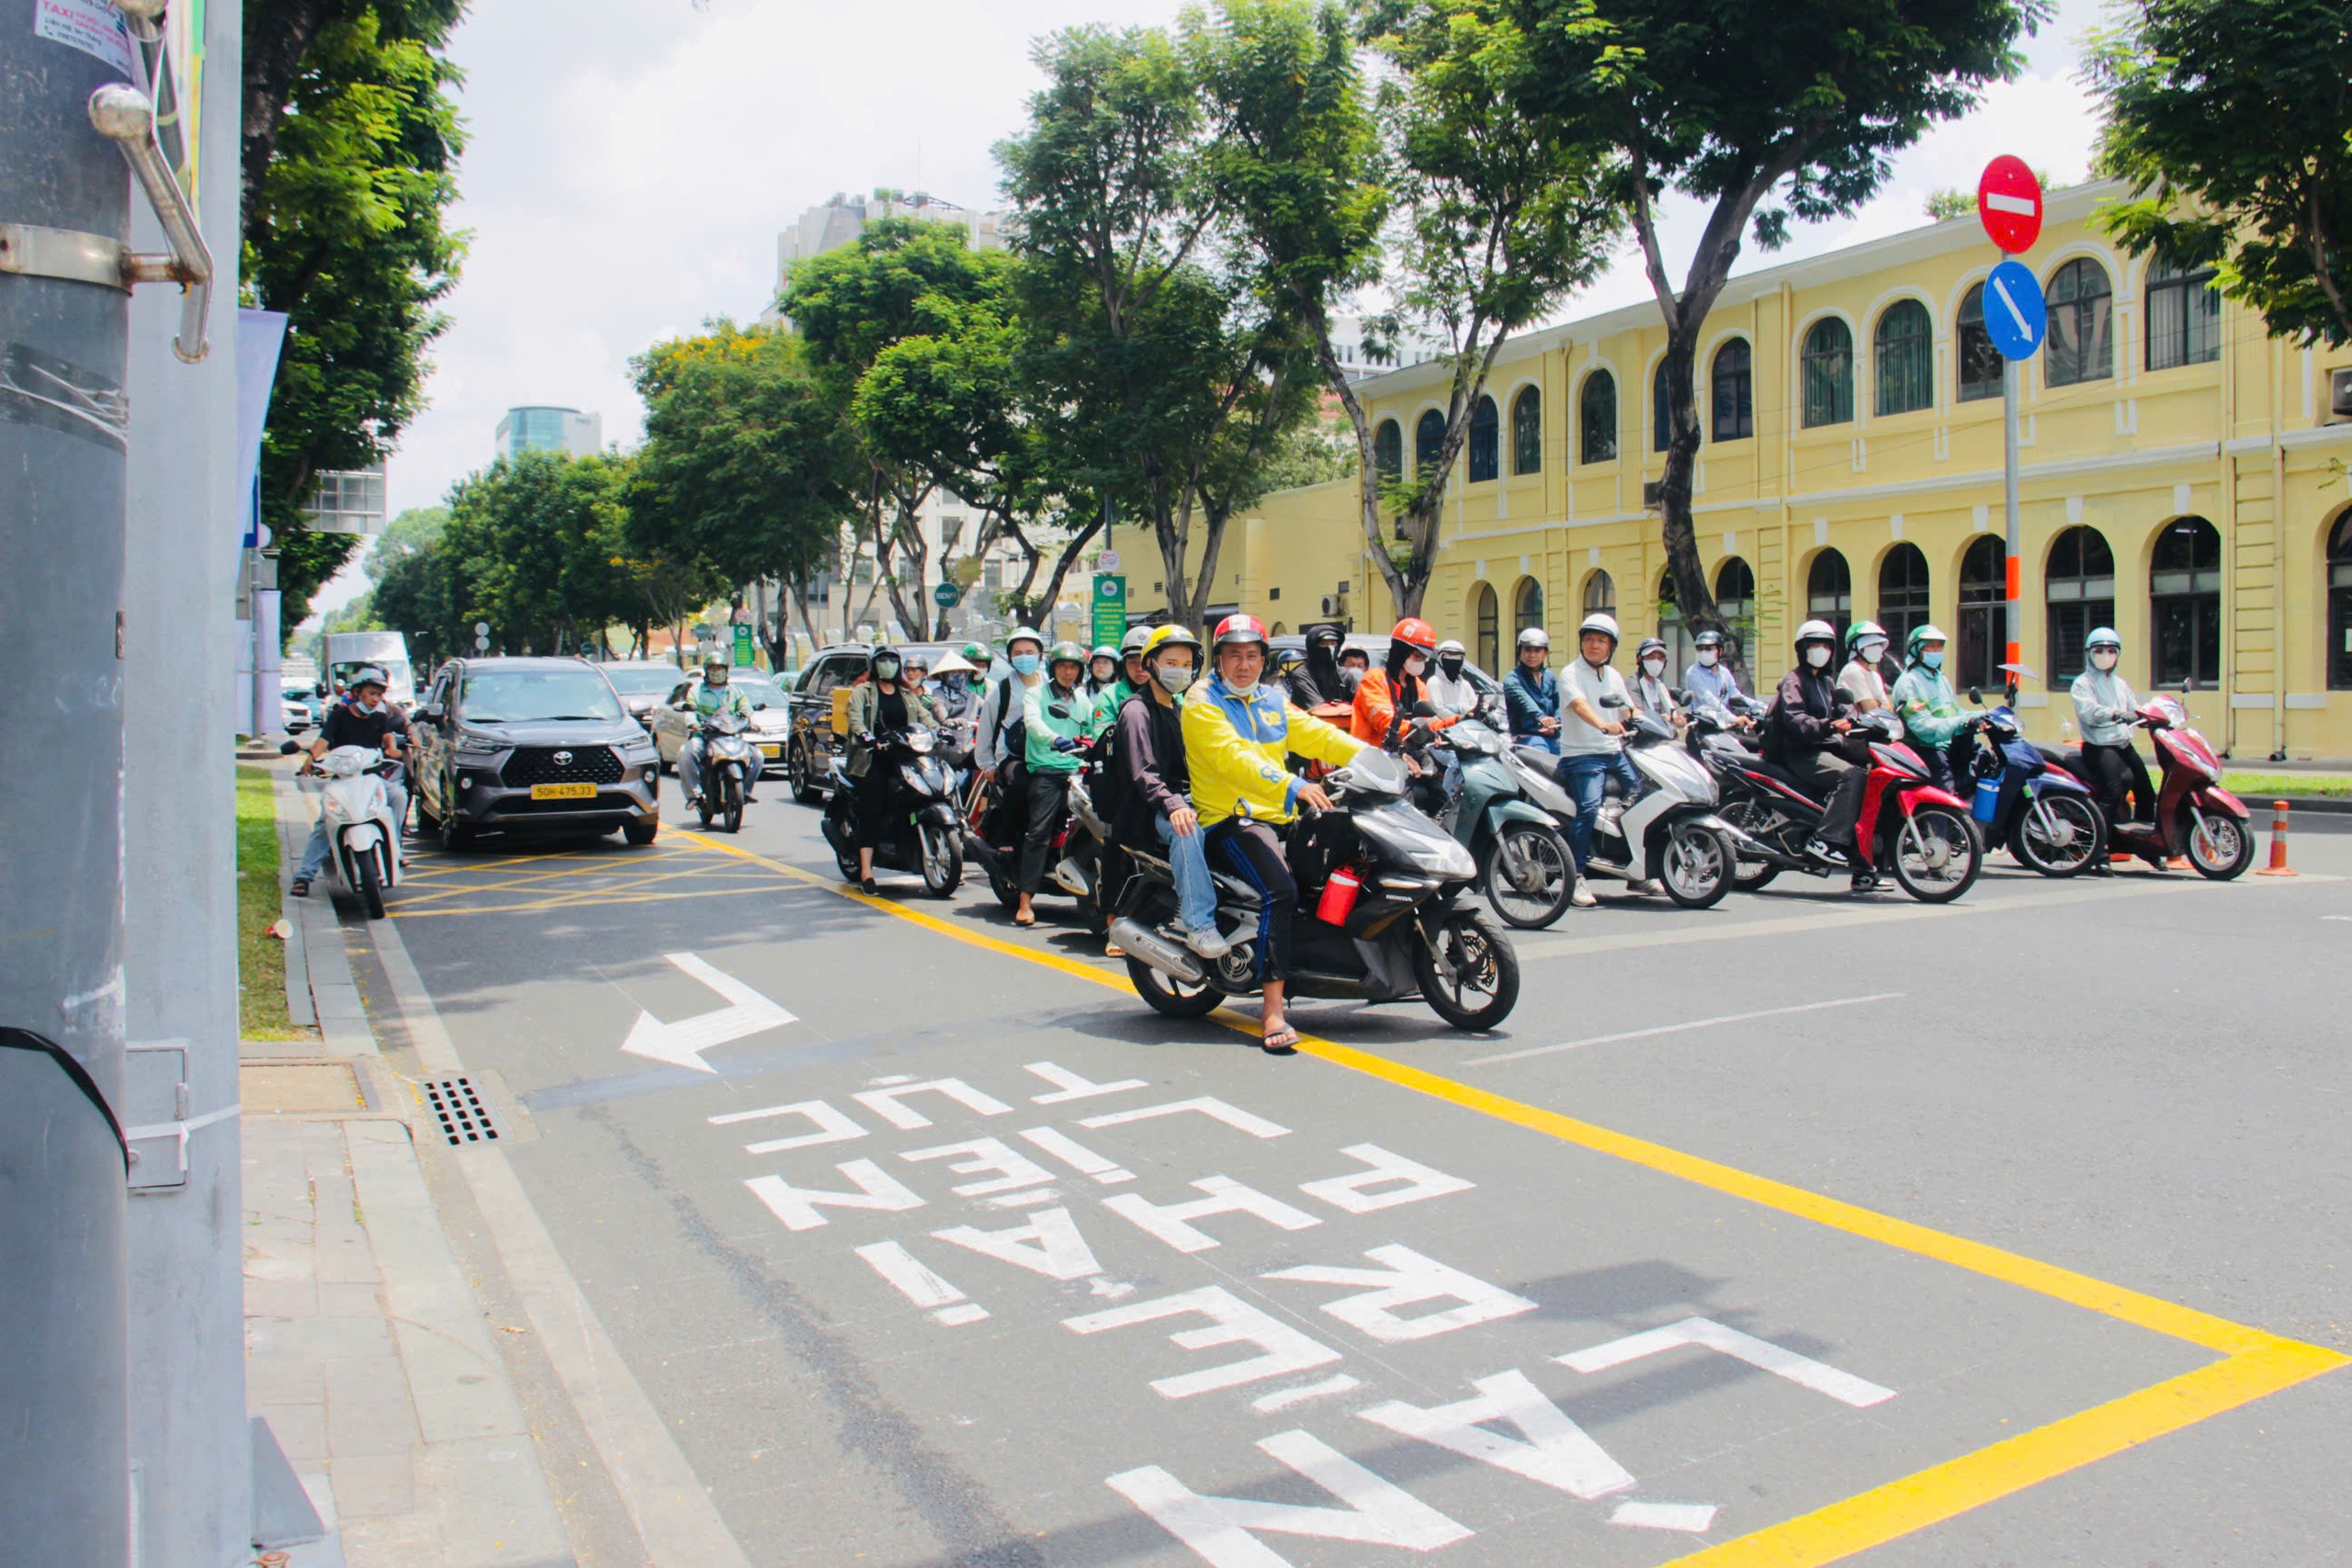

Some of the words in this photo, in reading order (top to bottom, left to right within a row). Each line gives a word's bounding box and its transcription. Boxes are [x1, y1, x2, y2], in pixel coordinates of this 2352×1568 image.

[44, 0, 73, 19] TAXI
[1258, 707, 1282, 726] be
[1386, 894, 1413, 902] HONDA
[707, 1061, 1150, 1155] TỤC
[1060, 1243, 1540, 1415] RẼ
[1104, 1315, 1899, 1568] LÀN
